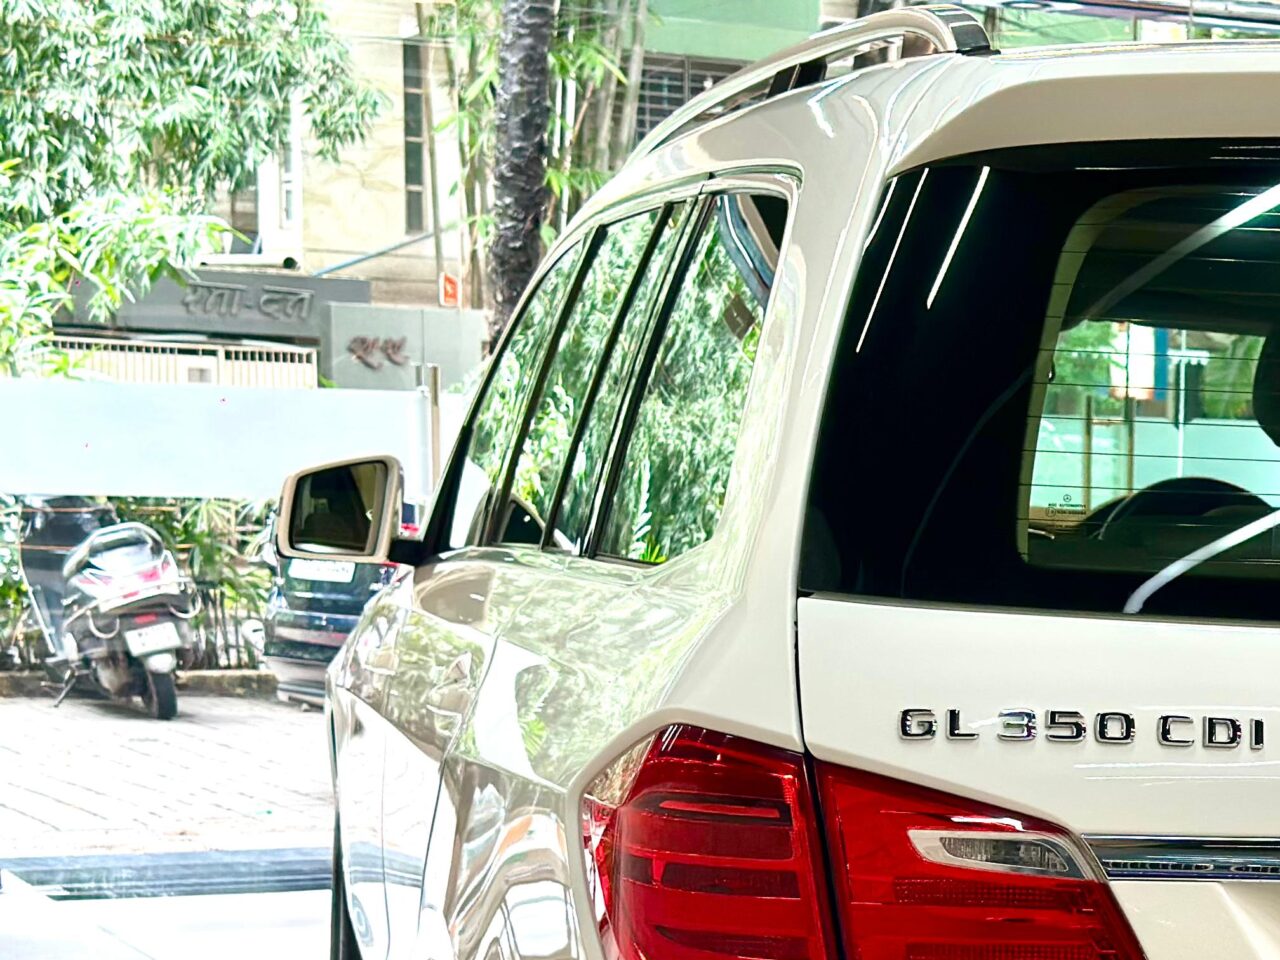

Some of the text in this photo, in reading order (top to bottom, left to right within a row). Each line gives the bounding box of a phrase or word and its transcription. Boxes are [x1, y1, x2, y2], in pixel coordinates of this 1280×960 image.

[897, 707, 1265, 750] GL 350 CDI
